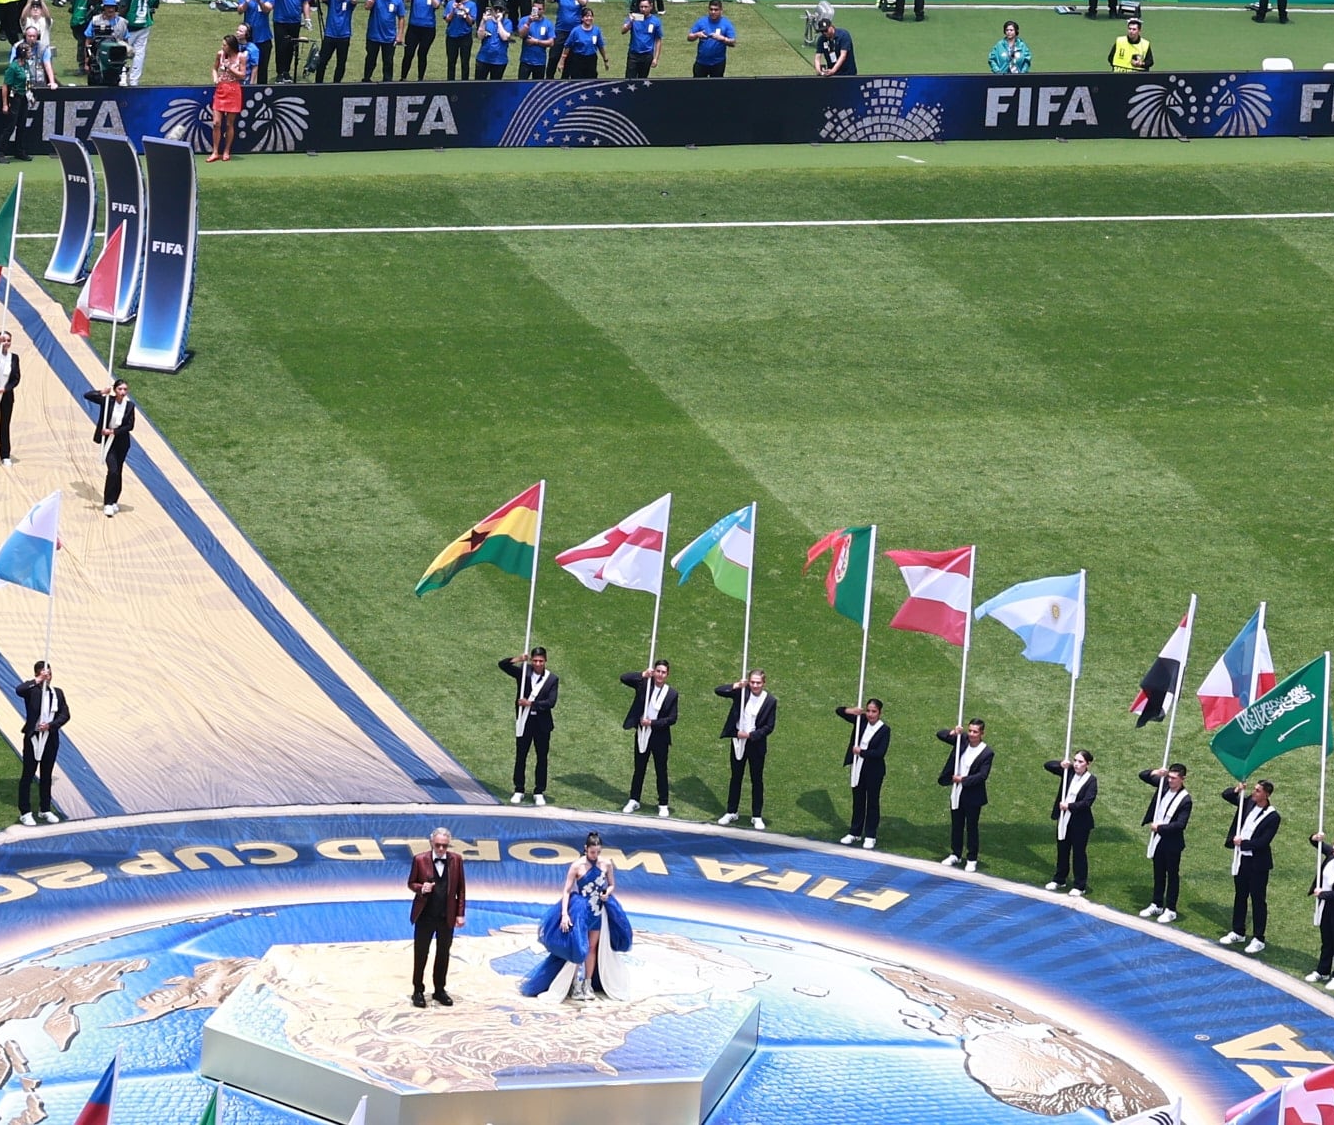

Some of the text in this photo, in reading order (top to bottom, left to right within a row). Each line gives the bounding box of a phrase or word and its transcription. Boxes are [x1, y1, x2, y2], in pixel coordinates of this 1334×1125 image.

[339, 93, 459, 138] FIFA
[984, 85, 1100, 128] FIFA
[67, 174, 88, 185] FIFA
[111, 202, 138, 215] FIFA
[151, 240, 185, 257] FIFA
[116, 839, 299, 875] CUP
[695, 854, 911, 913] FIFA
